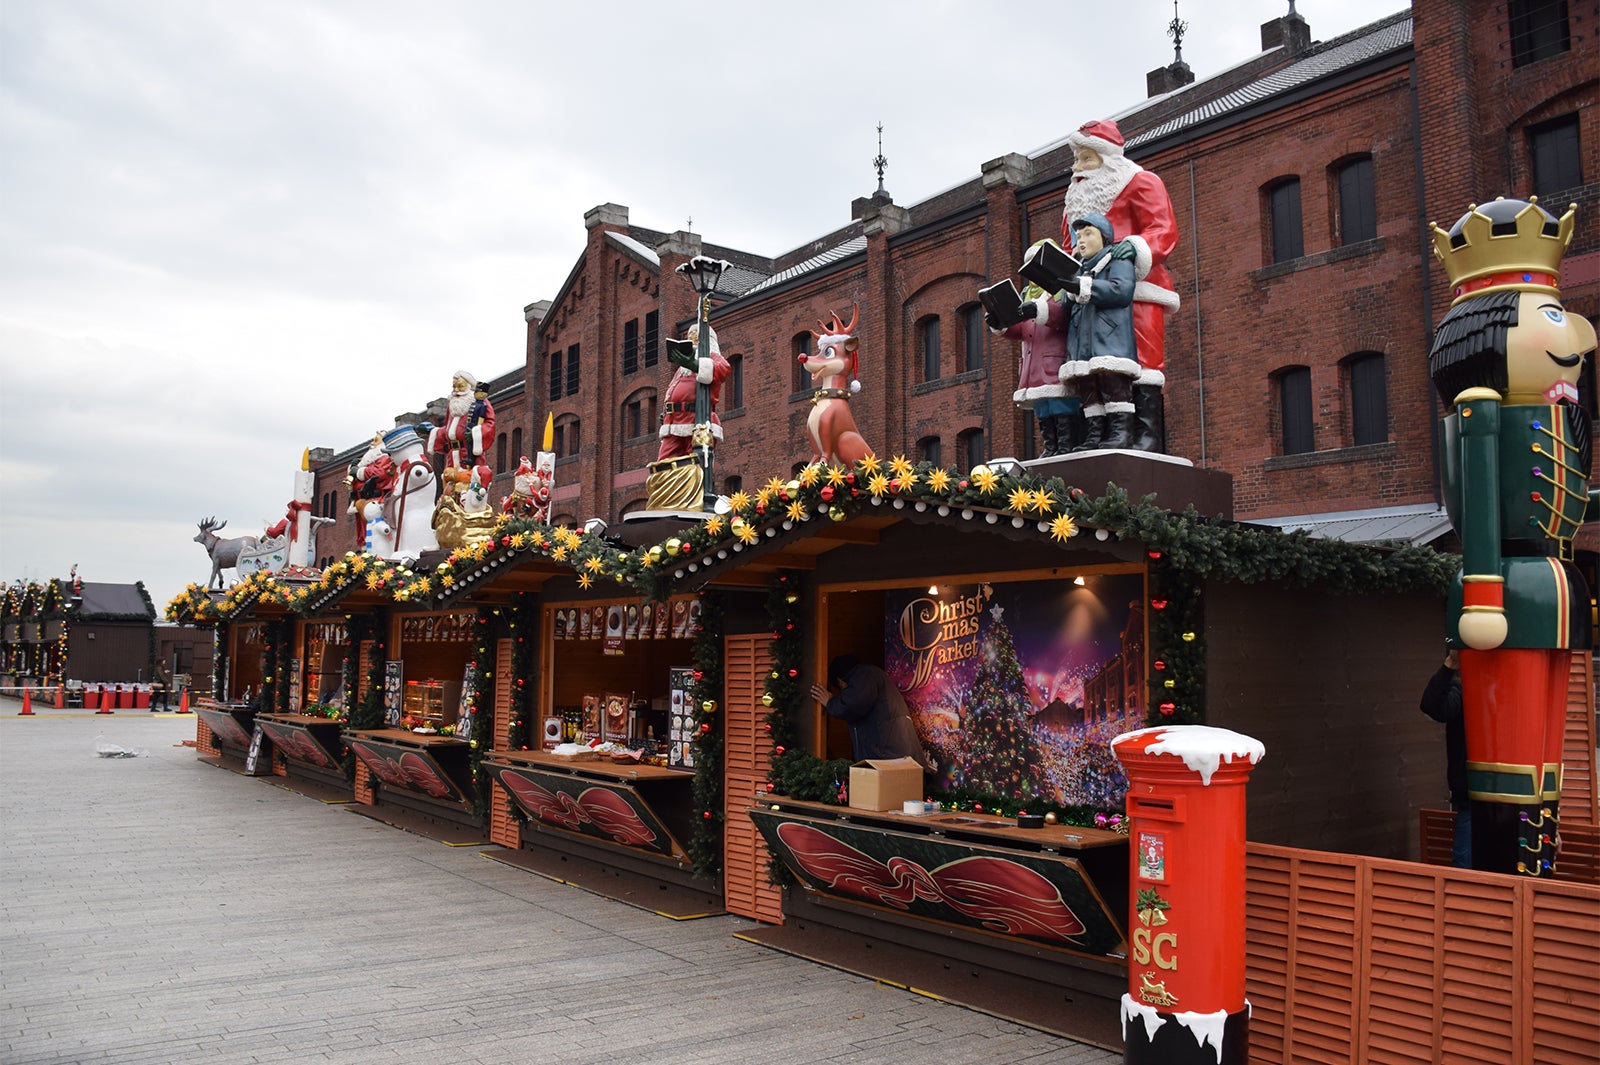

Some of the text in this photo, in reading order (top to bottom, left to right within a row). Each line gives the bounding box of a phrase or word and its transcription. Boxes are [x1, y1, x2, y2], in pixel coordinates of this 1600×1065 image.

[901, 584, 983, 651] Christ
[942, 616, 979, 641] mas
[900, 635, 978, 692] Market
[1133, 927, 1177, 970] SC
[1143, 993, 1171, 1006] EXPRESS
